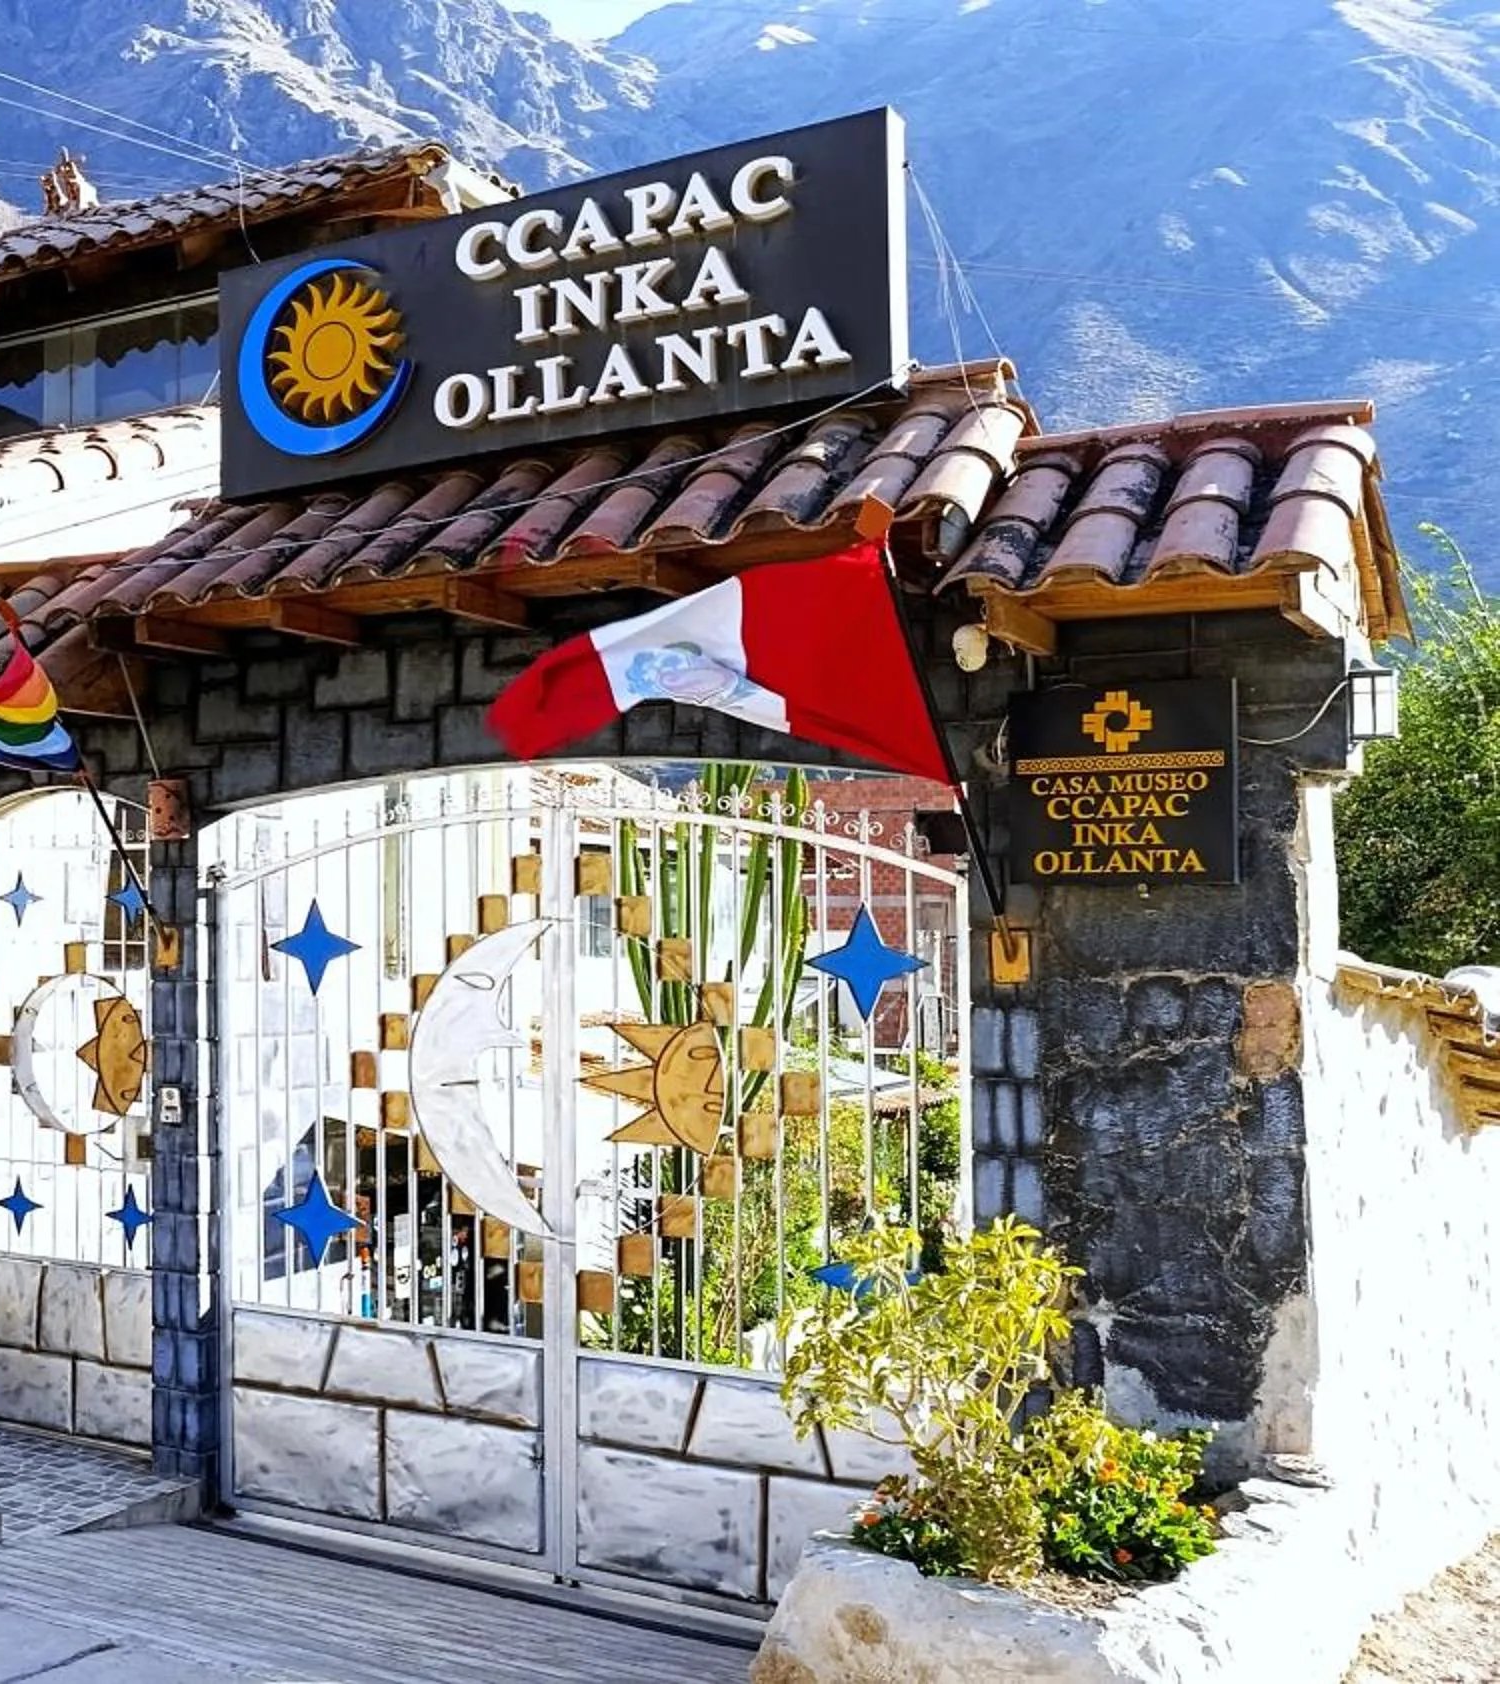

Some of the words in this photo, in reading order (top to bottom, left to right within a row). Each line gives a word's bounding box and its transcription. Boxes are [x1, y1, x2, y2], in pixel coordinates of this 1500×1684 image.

[455, 155, 795, 282] CCAPAC
[513, 246, 749, 343] INKA
[433, 306, 852, 429] OLLANTA
[1031, 776, 1102, 796] CASA
[1110, 771, 1209, 794] MUSEO
[1047, 793, 1190, 820] CCAPAC
[1072, 821, 1165, 847] INKA
[1033, 848, 1206, 875] OLLANTA
